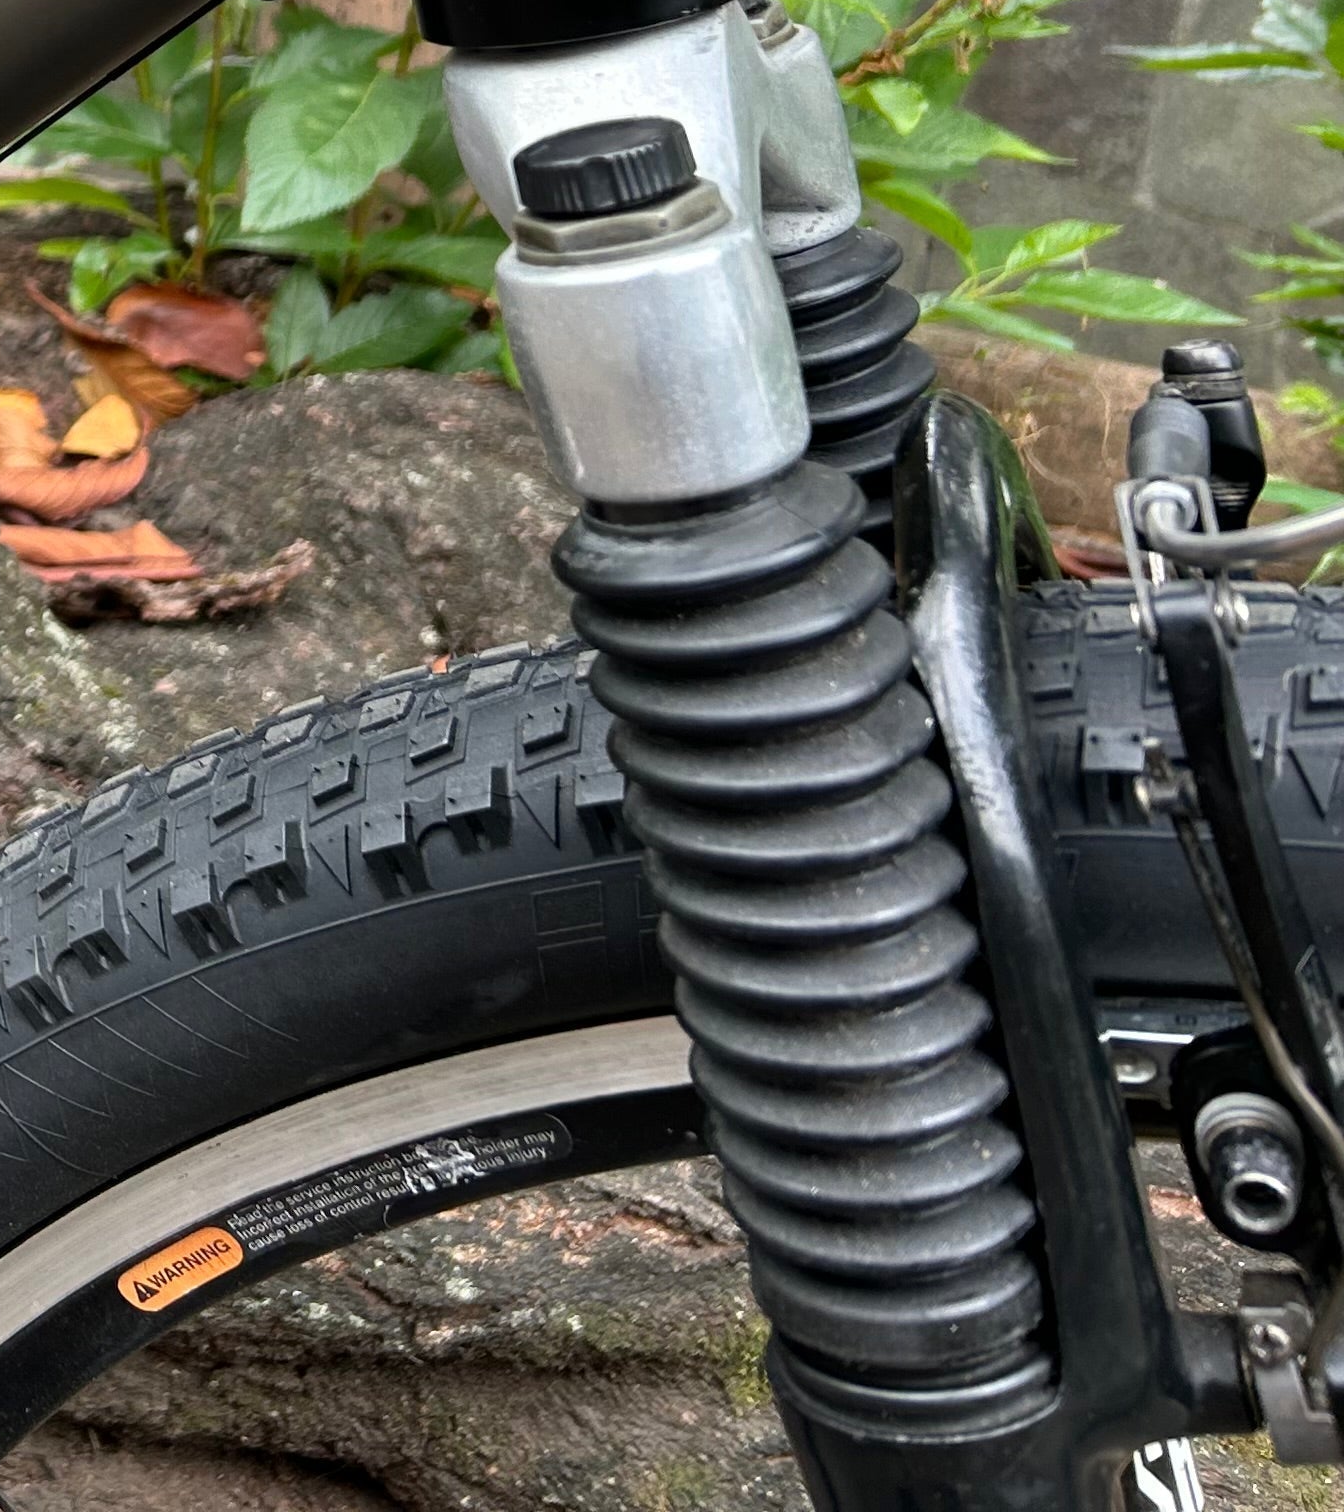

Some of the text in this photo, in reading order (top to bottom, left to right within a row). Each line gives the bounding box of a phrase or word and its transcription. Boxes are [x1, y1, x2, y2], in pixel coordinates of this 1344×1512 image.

[236, 1130, 556, 1240] Incorrect installation of the holder may
[286, 1180, 332, 1206] service
[333, 1154, 403, 1187] instruction
[248, 1228, 287, 1252] cause
[286, 1216, 314, 1236] loss
[314, 1208, 328, 1224] of
[329, 1191, 376, 1217] control
[146, 1238, 232, 1289] WARNING
